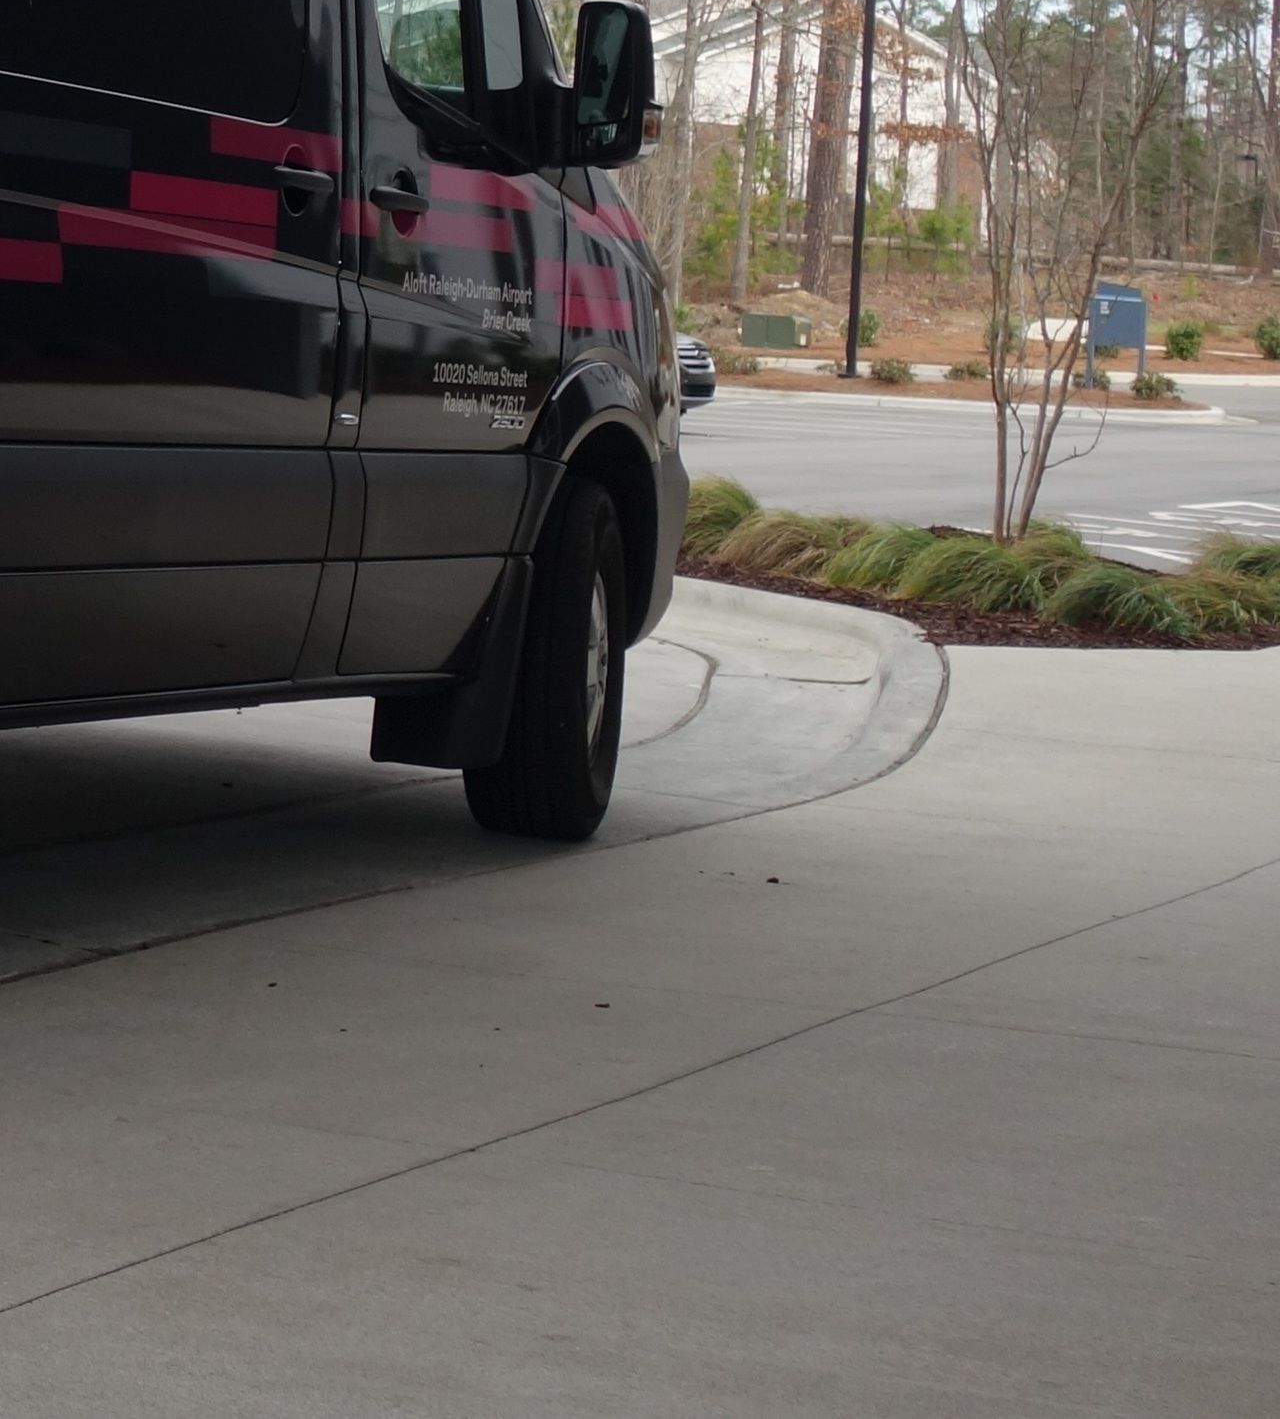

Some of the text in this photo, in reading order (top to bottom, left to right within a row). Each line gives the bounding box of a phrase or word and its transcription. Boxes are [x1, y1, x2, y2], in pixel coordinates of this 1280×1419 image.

[402, 271, 533, 307] Aloft Raleigh-Durham Airport
[482, 308, 531, 332] Brier Creek
[432, 362, 528, 388] 10020 Sellona Street
[443, 391, 526, 417] Raleigh, NC 27617
[491, 415, 525, 429] 2500
